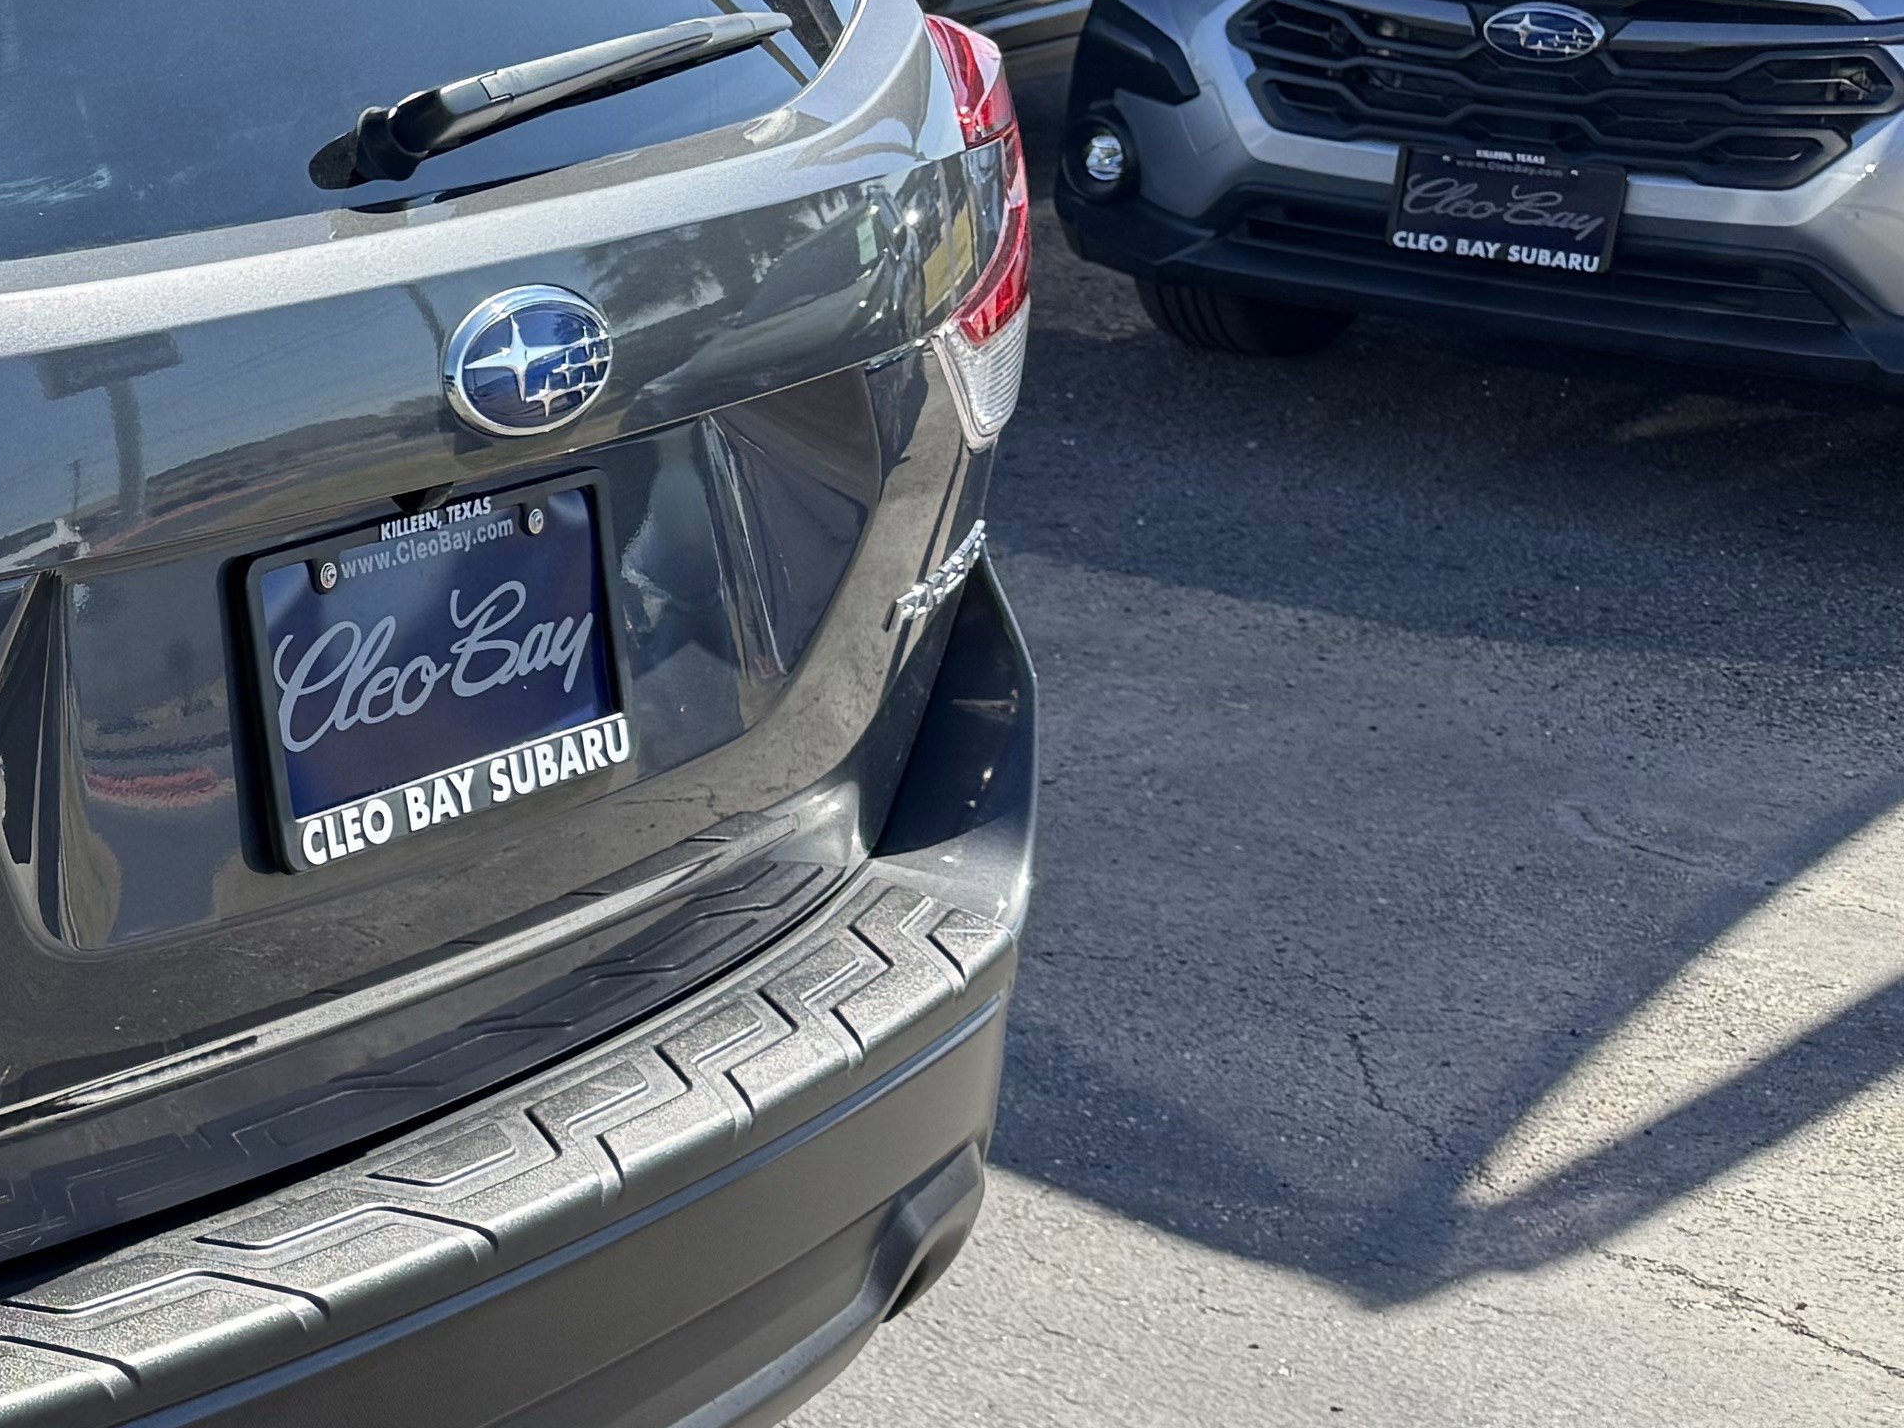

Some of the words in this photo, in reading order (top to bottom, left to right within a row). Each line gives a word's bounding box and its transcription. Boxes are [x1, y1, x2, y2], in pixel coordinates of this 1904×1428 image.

[1402, 173, 1504, 220] Cleo
[1502, 184, 1605, 241] Bay
[1392, 230, 1448, 253] CLEO
[1456, 238, 1501, 259] BAY
[1507, 244, 1600, 273] SUBARU
[341, 516, 514, 579] www.CleoBay.com
[379, 510, 442, 542] KILLEEN,
[446, 496, 492, 524] TEXAS
[273, 615, 451, 752] Cleo
[450, 580, 593, 697] Bay
[302, 798, 394, 865] CLEO
[405, 767, 474, 832] BAY
[491, 718, 630, 803] SUBARU
